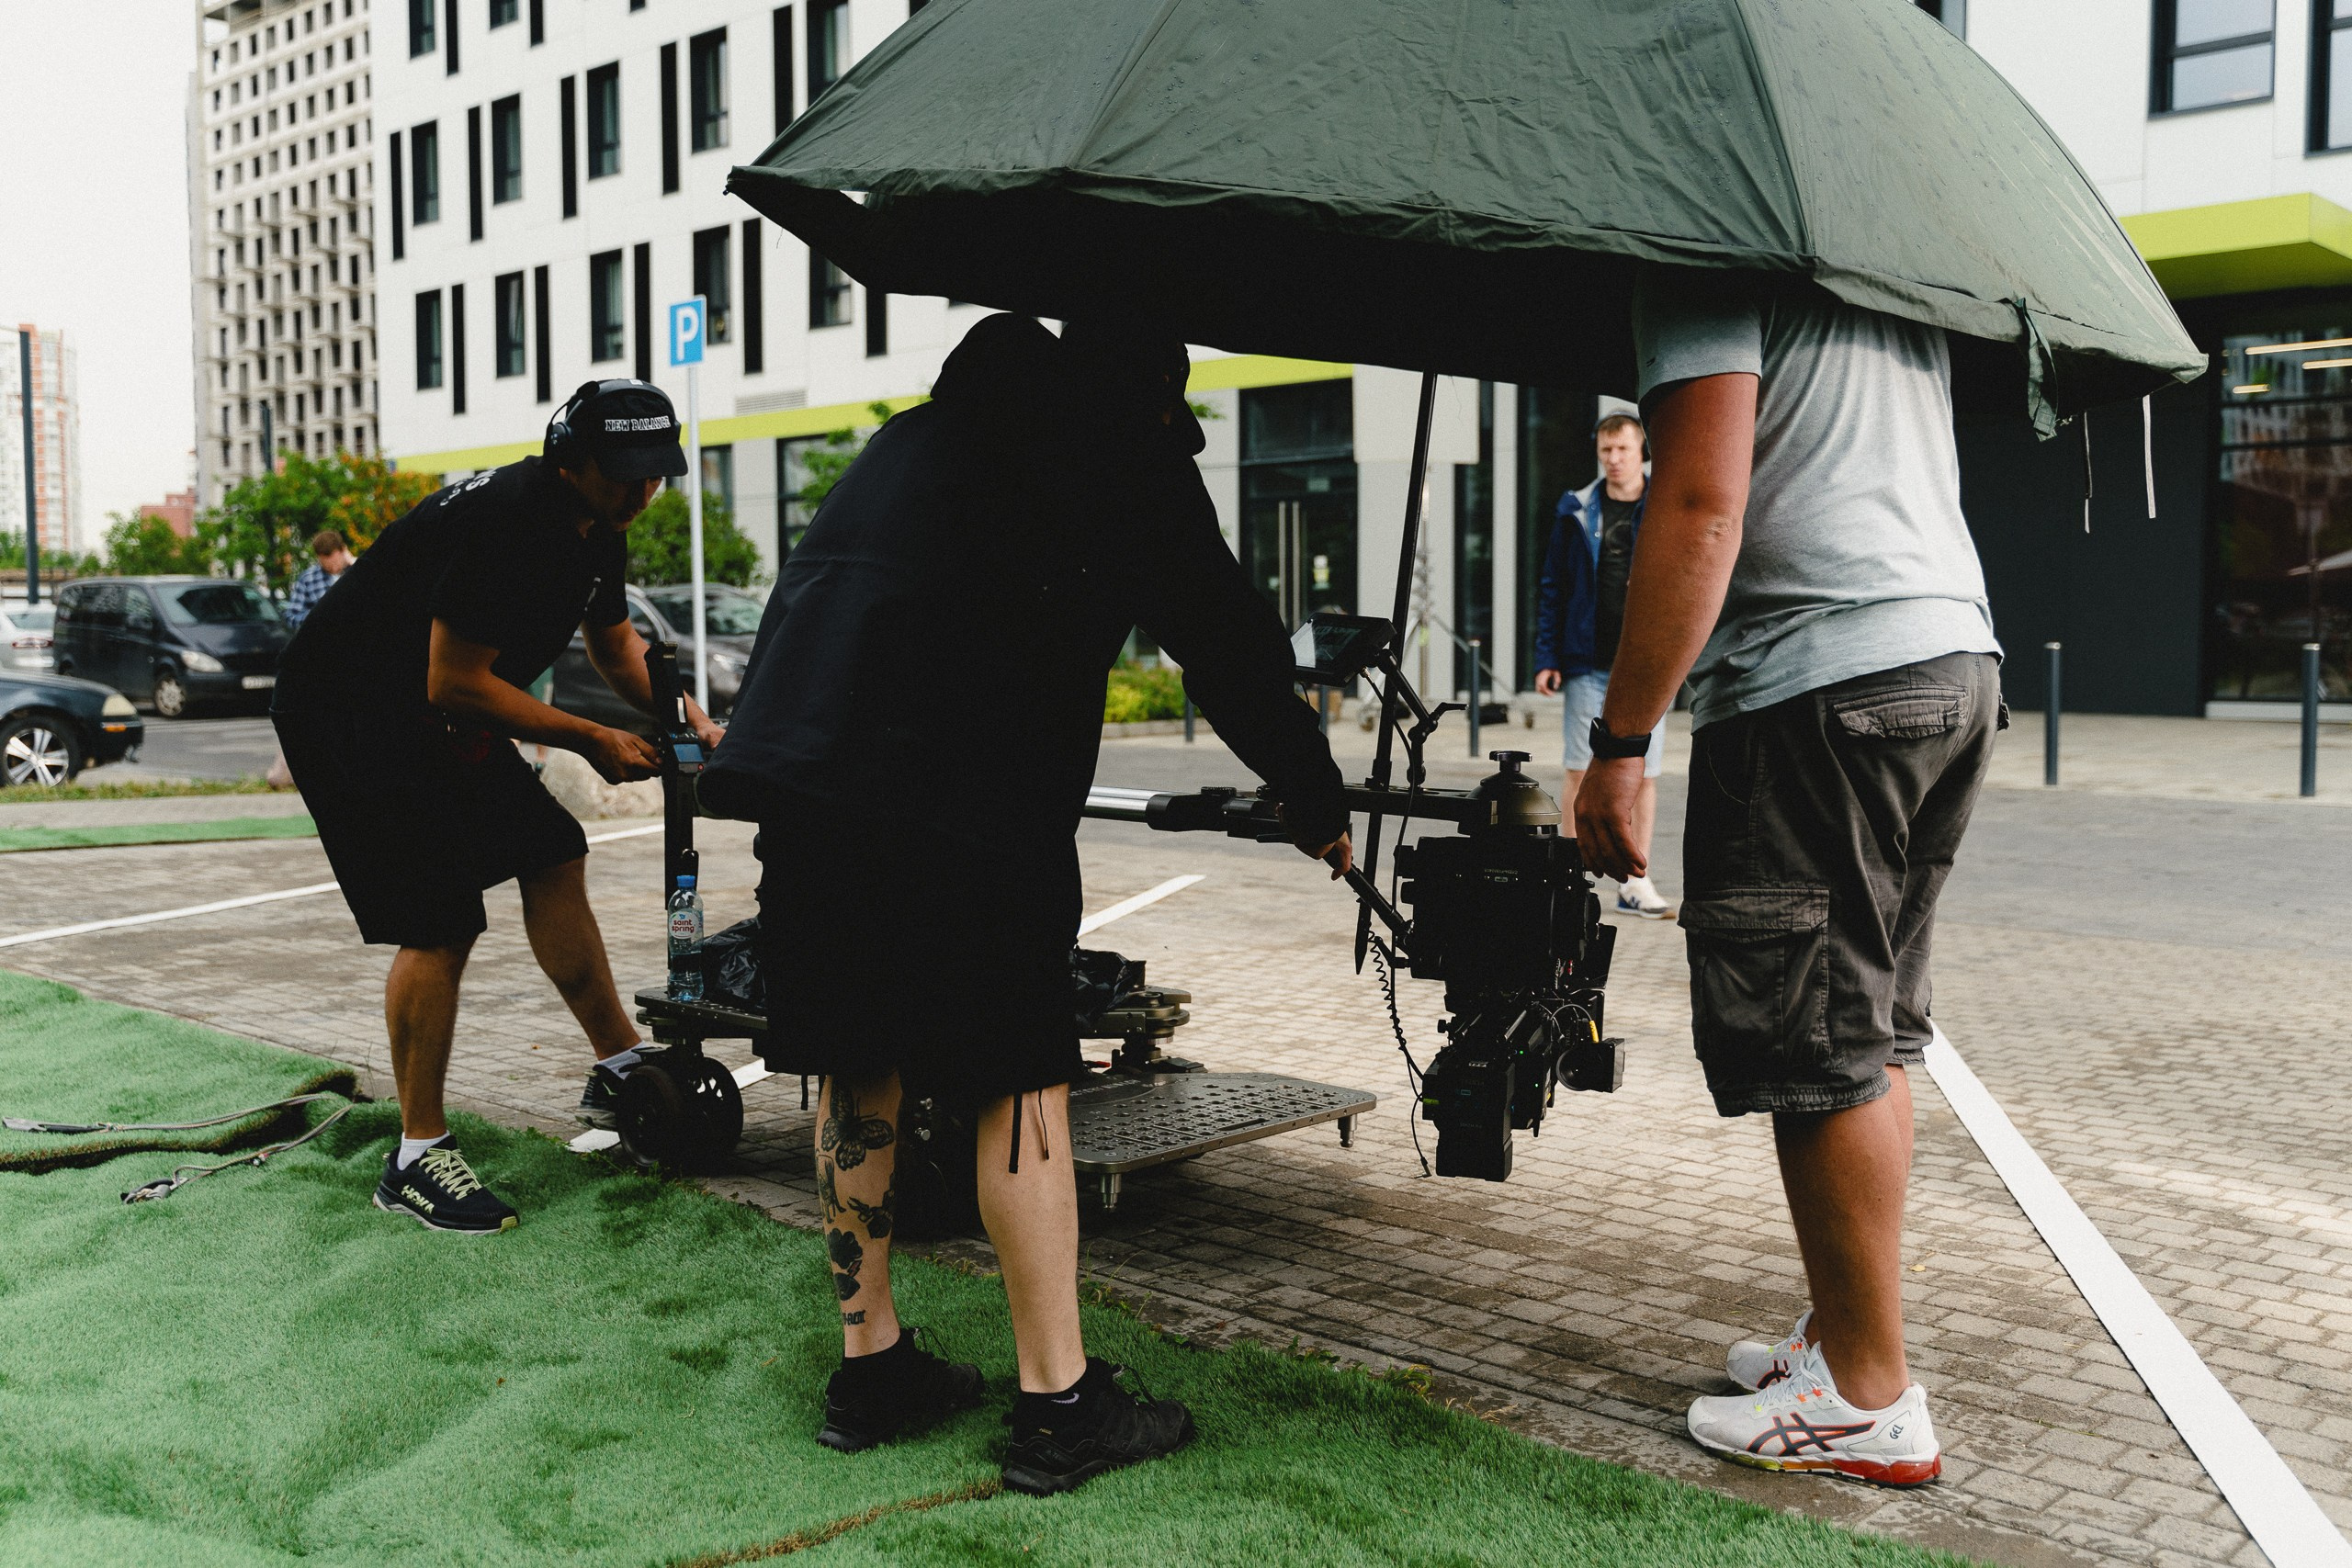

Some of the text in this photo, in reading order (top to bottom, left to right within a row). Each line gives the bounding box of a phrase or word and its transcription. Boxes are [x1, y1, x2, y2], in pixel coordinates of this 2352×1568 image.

[676, 306, 699, 361] P
[605, 415, 672, 432] NEW BALANCE
[672, 925, 695, 933] spring
[1889, 1424, 1905, 1439] GEL
